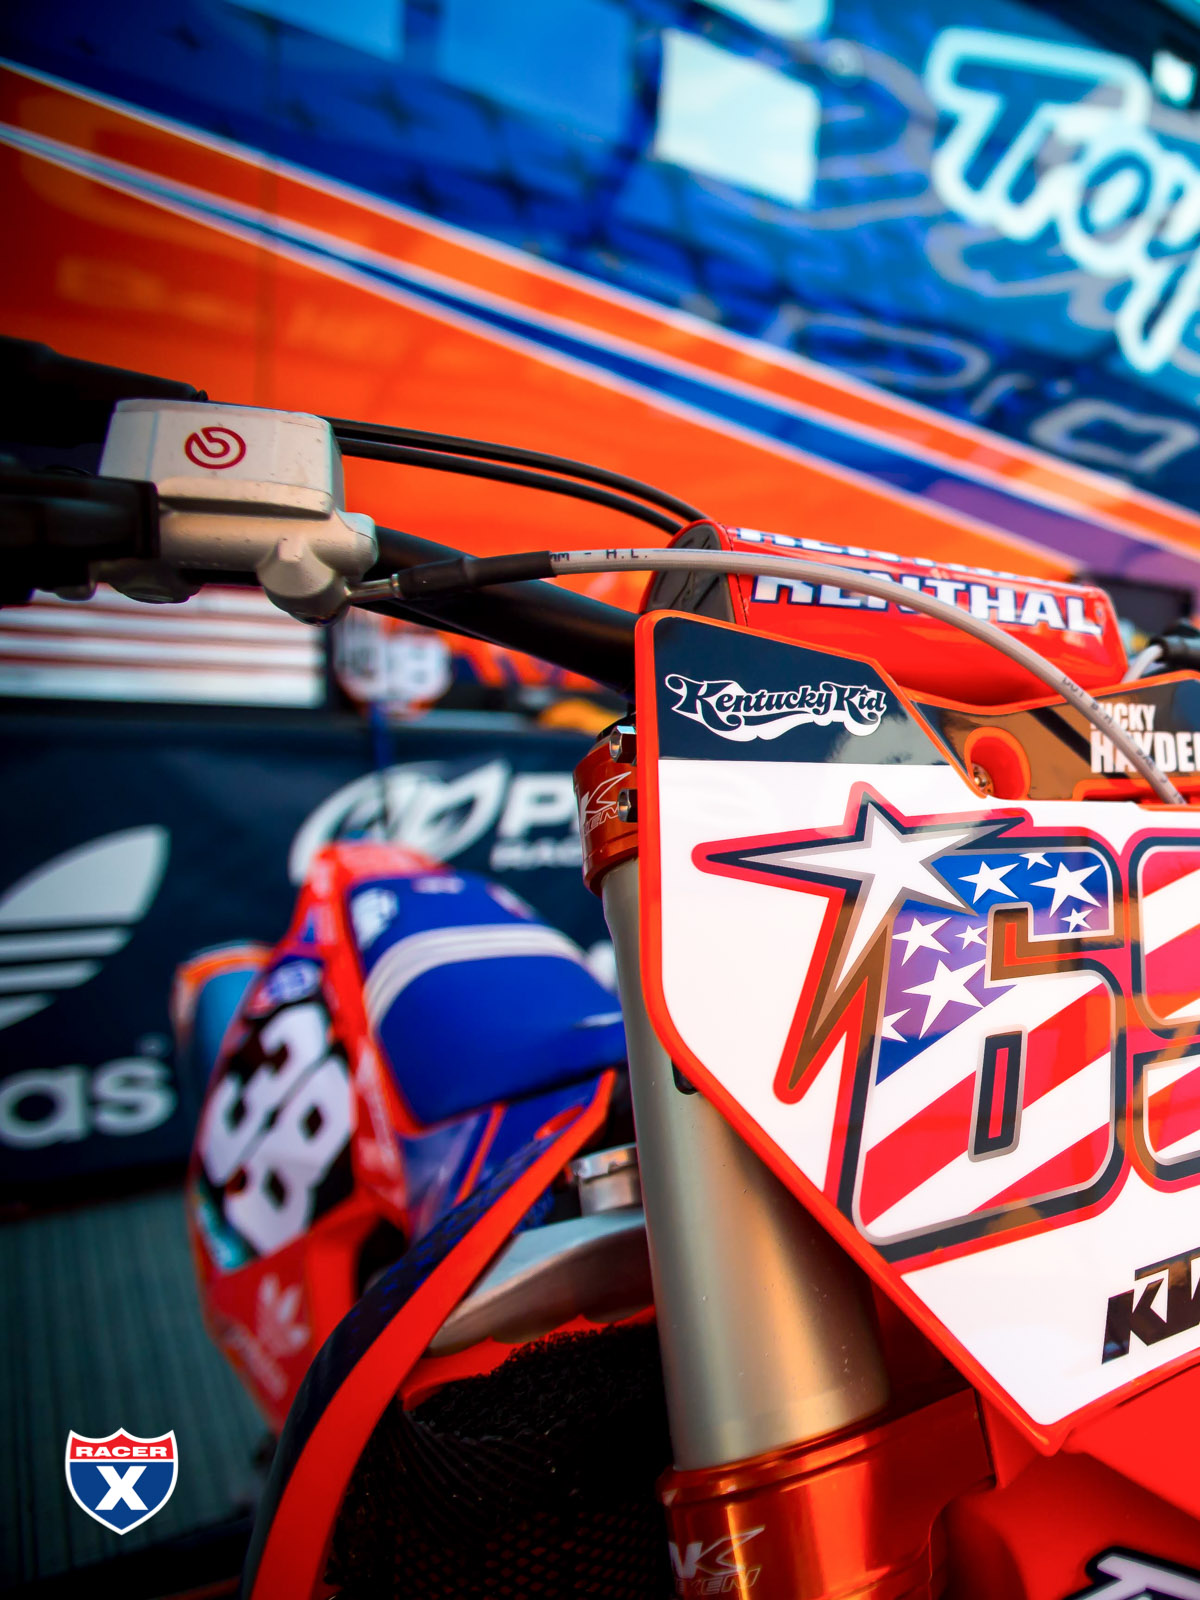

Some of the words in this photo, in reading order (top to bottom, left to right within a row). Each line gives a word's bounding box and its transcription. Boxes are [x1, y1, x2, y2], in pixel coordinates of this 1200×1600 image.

[665, 674, 833, 738] Kentucky
[821, 681, 887, 733] Kid
[199, 1000, 358, 1258] 38
